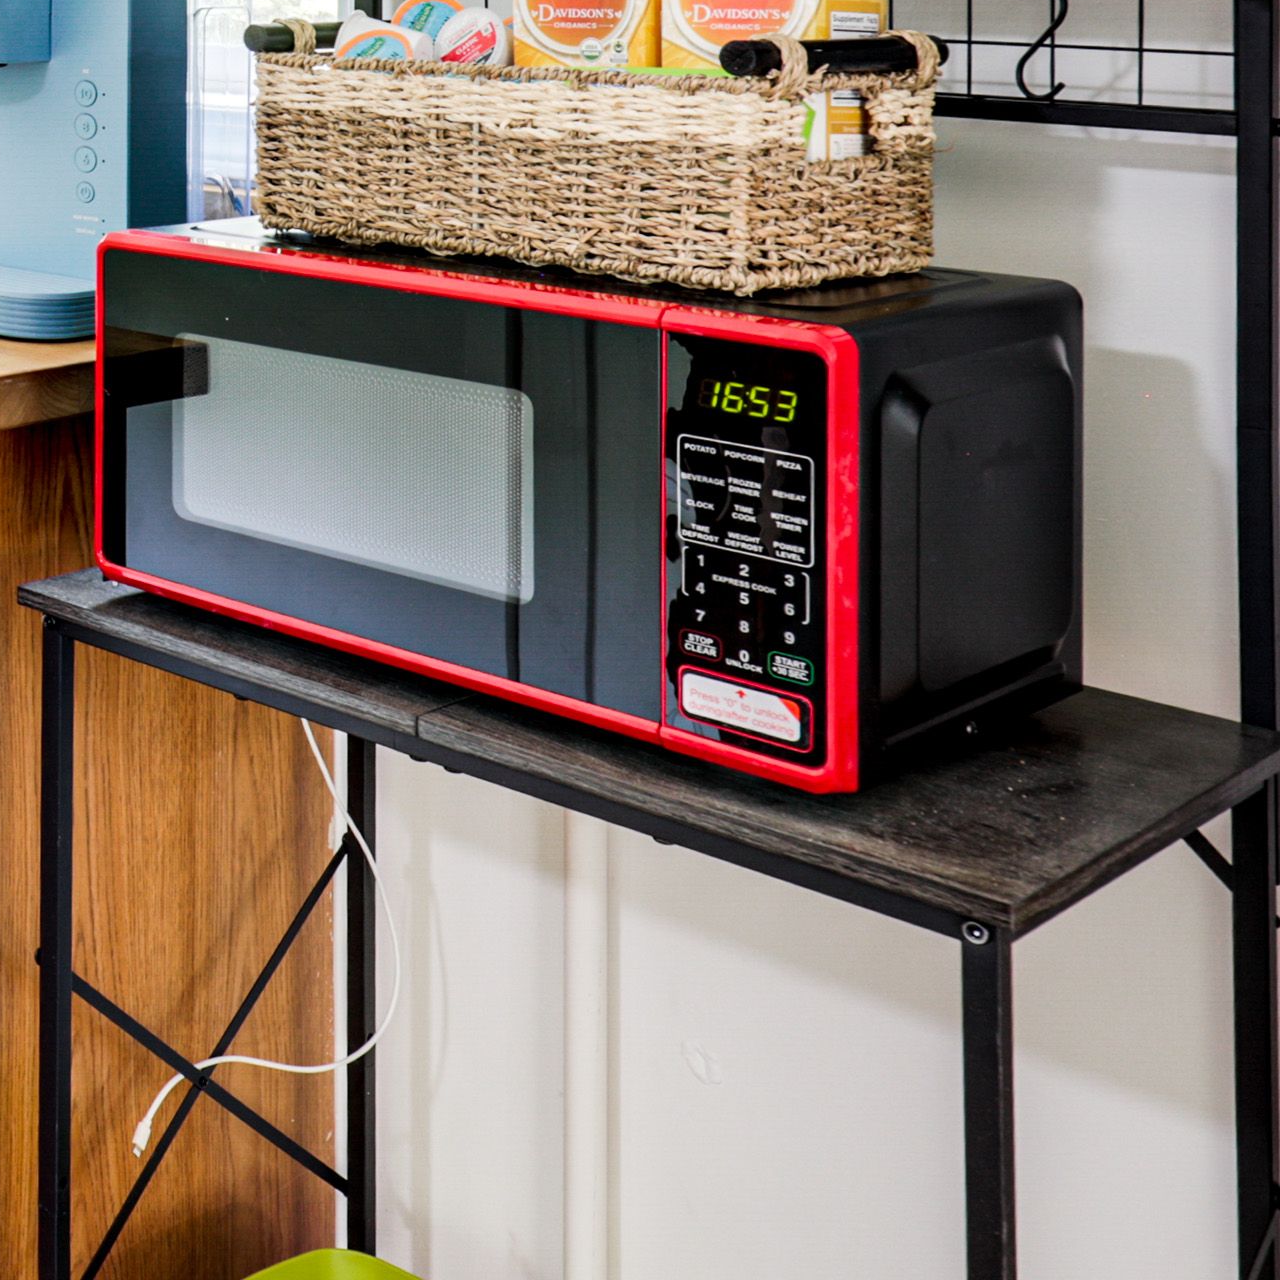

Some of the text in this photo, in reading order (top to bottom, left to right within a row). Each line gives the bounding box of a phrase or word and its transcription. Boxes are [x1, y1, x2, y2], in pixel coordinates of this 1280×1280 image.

[709, 23, 762, 31] ORGANICS
[711, 381, 798, 422] 16:53
[684, 442, 717, 455] POTATO
[724, 450, 765, 464] POPCORN
[776, 459, 802, 471] PIZZA
[681, 471, 725, 486] BEVERAGE
[728, 476, 762, 489] FROZEN
[728, 485, 760, 497] DINNER
[771, 489, 807, 502] REHEAT
[685, 499, 715, 510] CLOCK
[733, 504, 754, 515] TIME
[731, 512, 757, 523] COOK
[770, 512, 808, 526] KITCHEN
[690, 523, 710, 533] TIME
[776, 521, 802, 533] TIMER
[681, 529, 719, 543] DEFROST
[727, 531, 761, 544] WEIGHT
[724, 539, 764, 552] DEFROST
[773, 541, 805, 554] POWER
[697, 554, 705, 567] 1
[775, 550, 803, 562] LEVEL
[739, 564, 750, 577] 2
[712, 574, 777, 595] EXPRESS COOK
[784, 574, 795, 587] 3
[695, 582, 705, 594] 4
[739, 592, 750, 605] 5
[695, 609, 706, 622] 7
[784, 603, 795, 616] 6
[739, 620, 750, 633] 8
[688, 633, 714, 645] STOP
[784, 631, 795, 645] 9
[684, 642, 717, 657] CLEAR
[739, 650, 750, 663] 0
[774, 655, 807, 669] START
[725, 658, 763, 674] UNLOCK
[690, 688, 720, 704] Press
[740, 703, 752, 712] to
[754, 707, 790, 721] unlock
[752, 719, 795, 738] cooking
